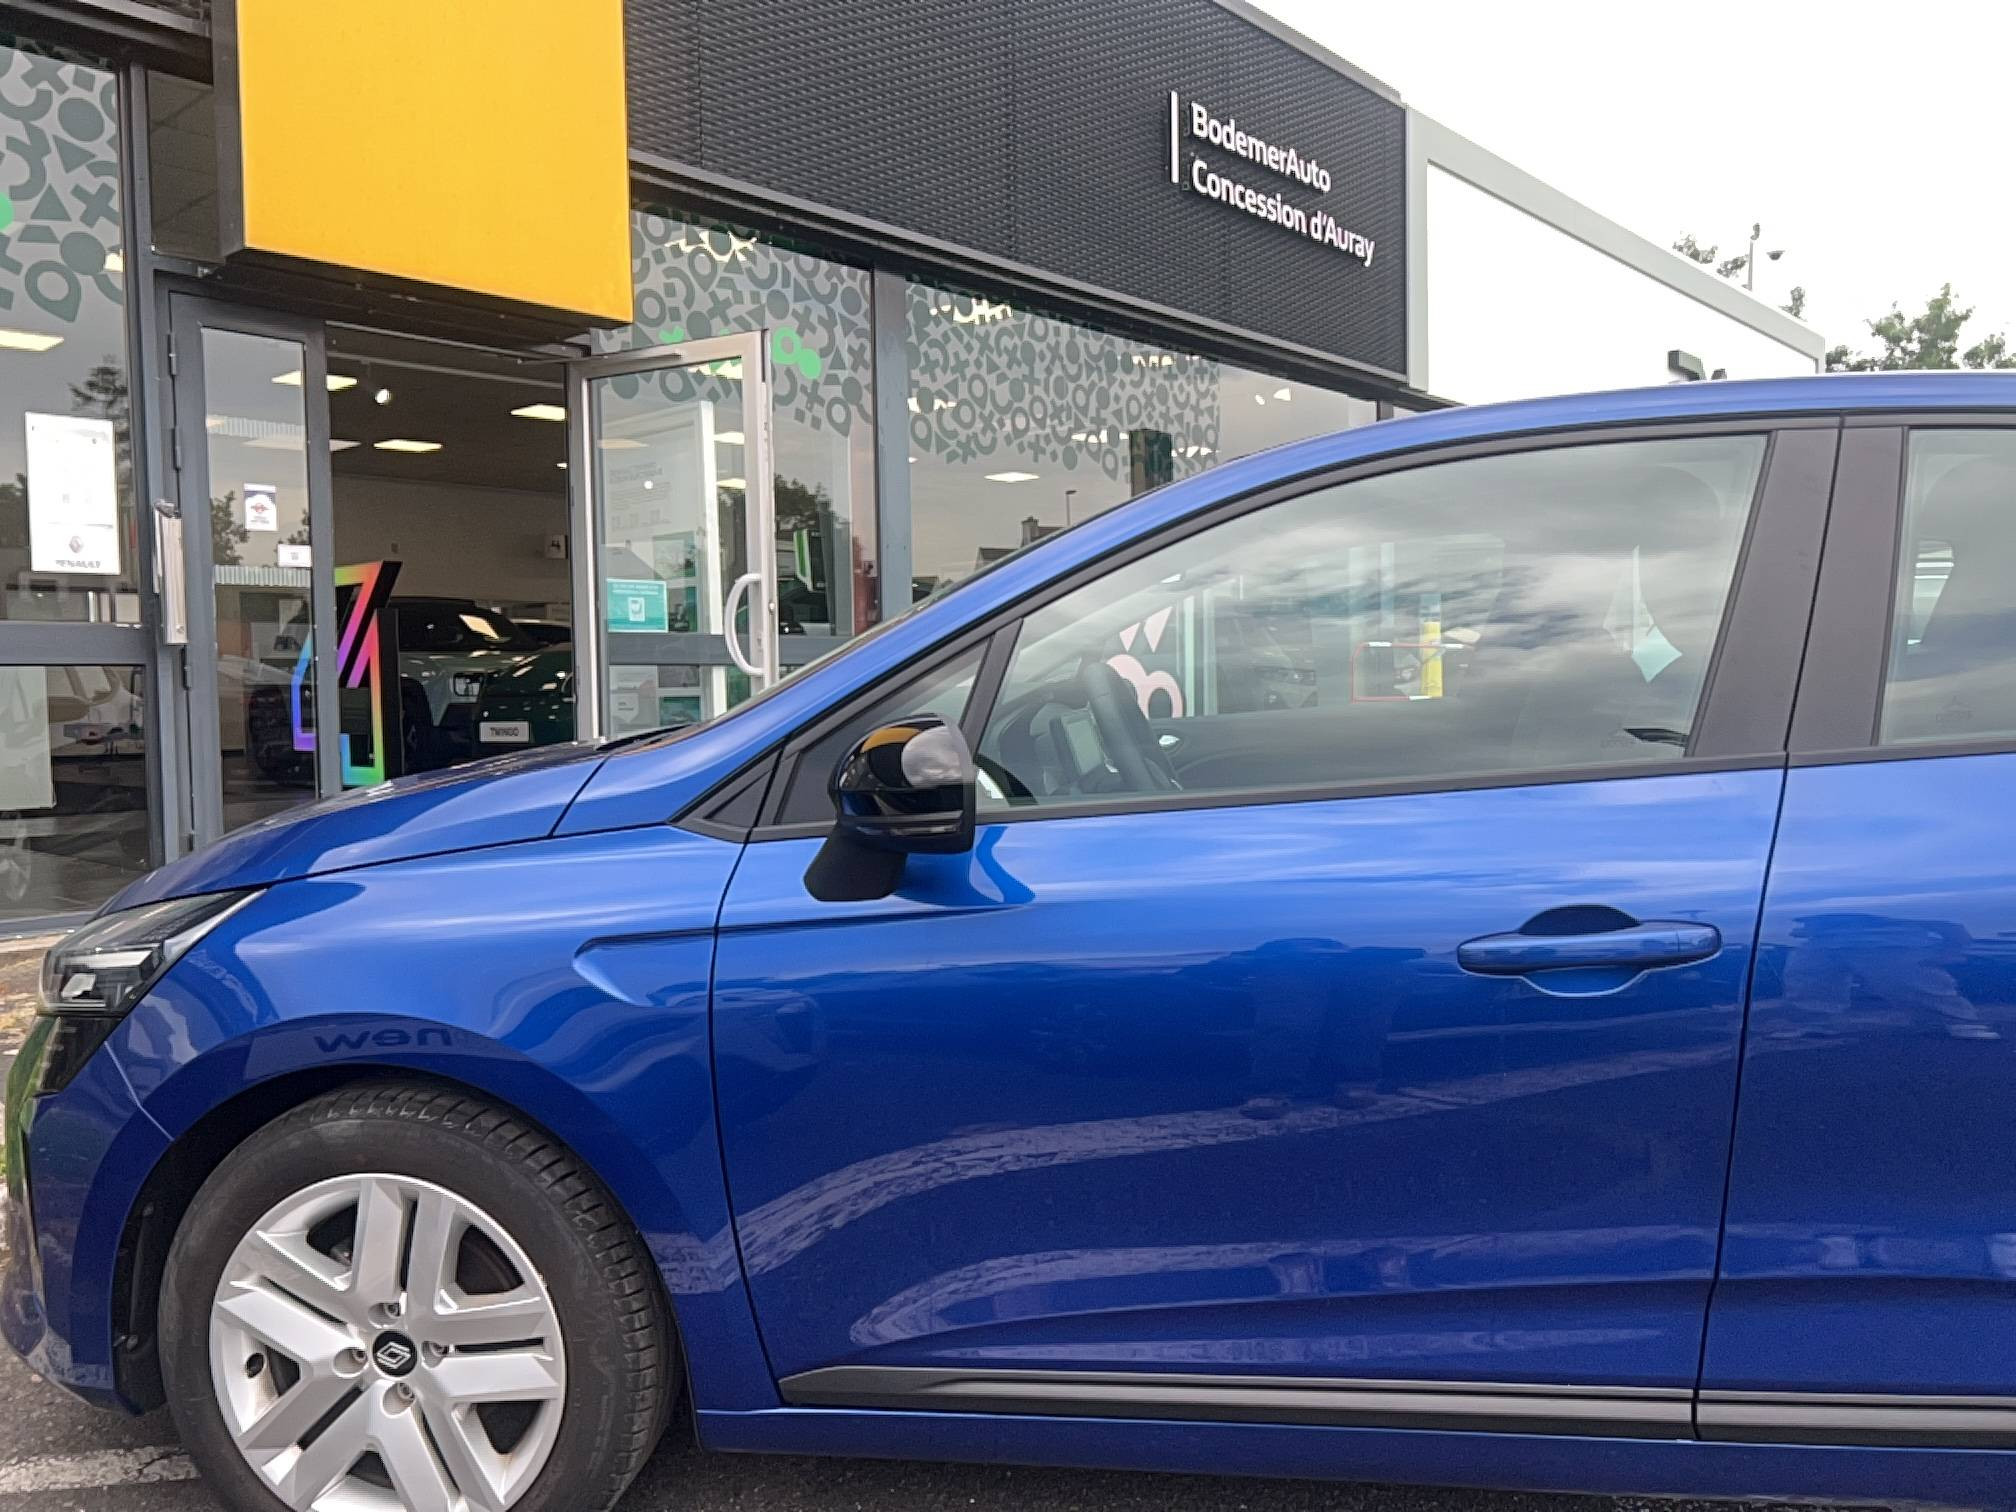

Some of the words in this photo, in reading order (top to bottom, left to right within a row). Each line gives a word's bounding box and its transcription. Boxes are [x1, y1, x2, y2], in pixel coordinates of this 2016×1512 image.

[1191, 101, 1332, 192] BodemerAuto
[1192, 159, 1307, 234] Concession
[1310, 210, 1375, 267] d'Auray
